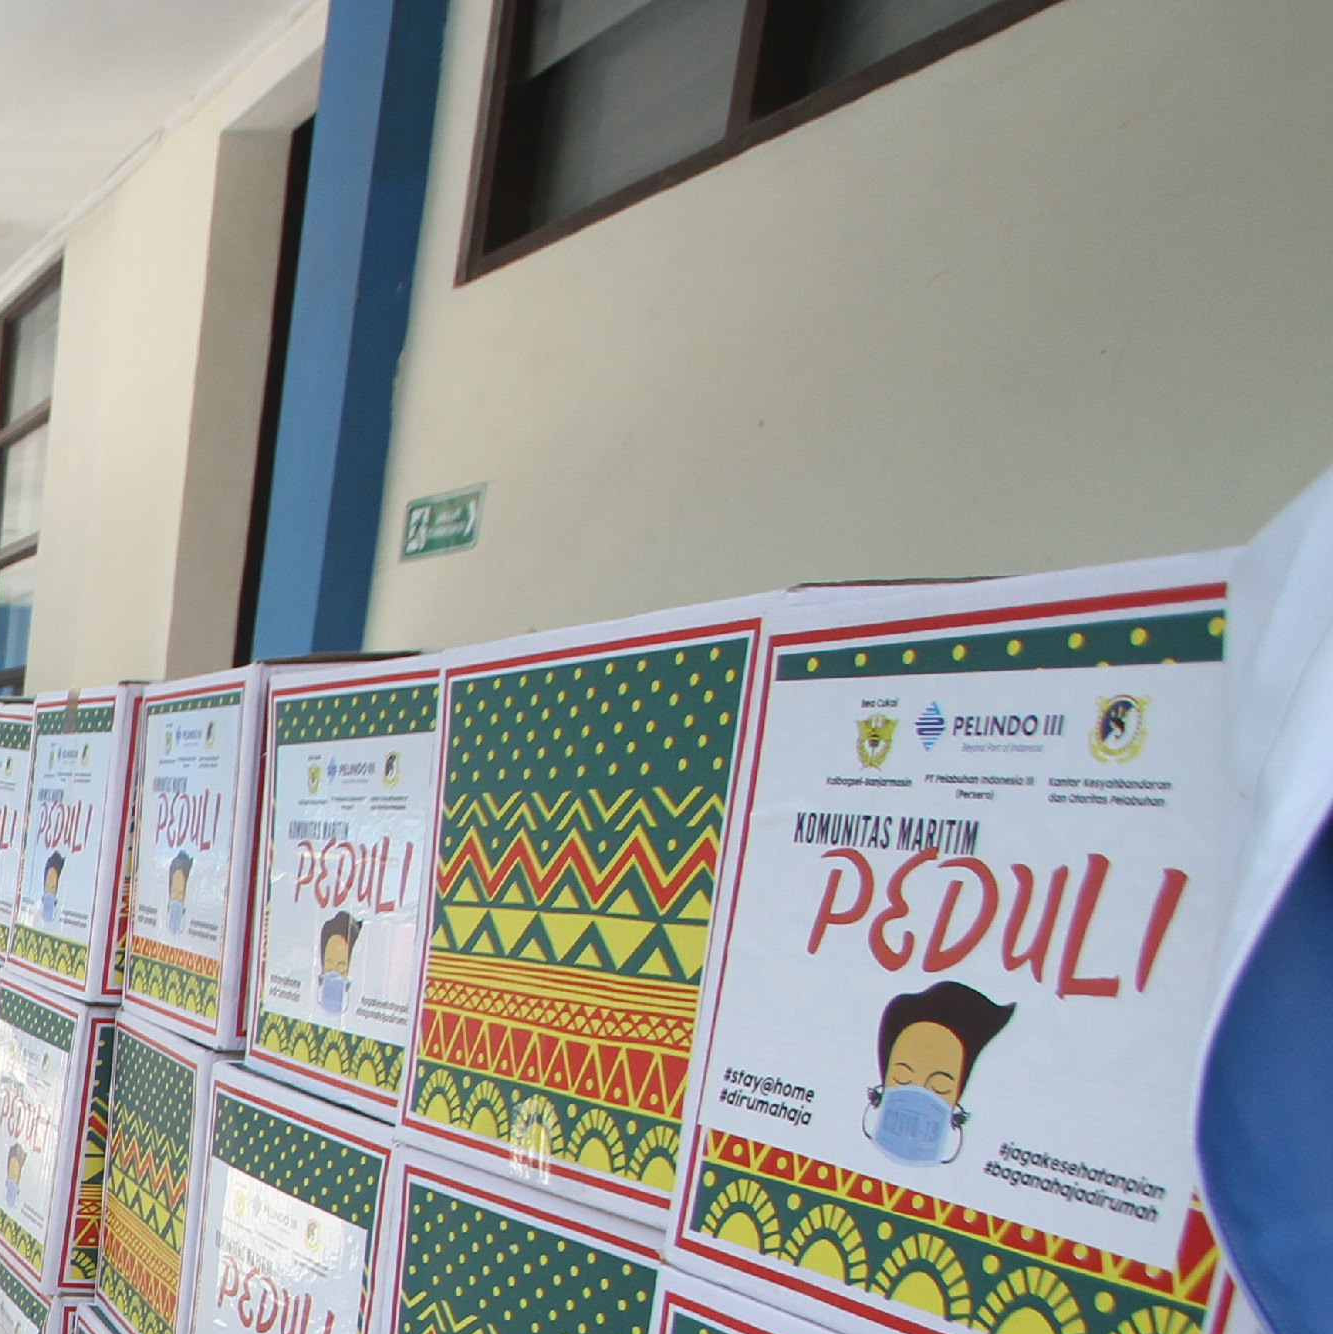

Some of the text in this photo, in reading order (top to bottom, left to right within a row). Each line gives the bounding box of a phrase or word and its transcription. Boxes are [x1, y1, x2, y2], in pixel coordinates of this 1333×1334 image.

[952, 713, 1066, 737] PELINDO III
[37, 799, 93, 853] PEDULI
[155, 788, 222, 851] PEDULI
[794, 812, 980, 855] KOMUNITAS MARITIM
[294, 836, 413, 914] PEDULI
[807, 847, 1188, 1000] PEDULI
[719, 1087, 812, 1126] #dirumahaja
[724, 1066, 814, 1103] #stay@home
[0, 1079, 52, 1154] PEDULI
[984, 1160, 1159, 1223] #baganahajadirumah
[999, 1140, 1166, 1199] #jagakesehatanpian
